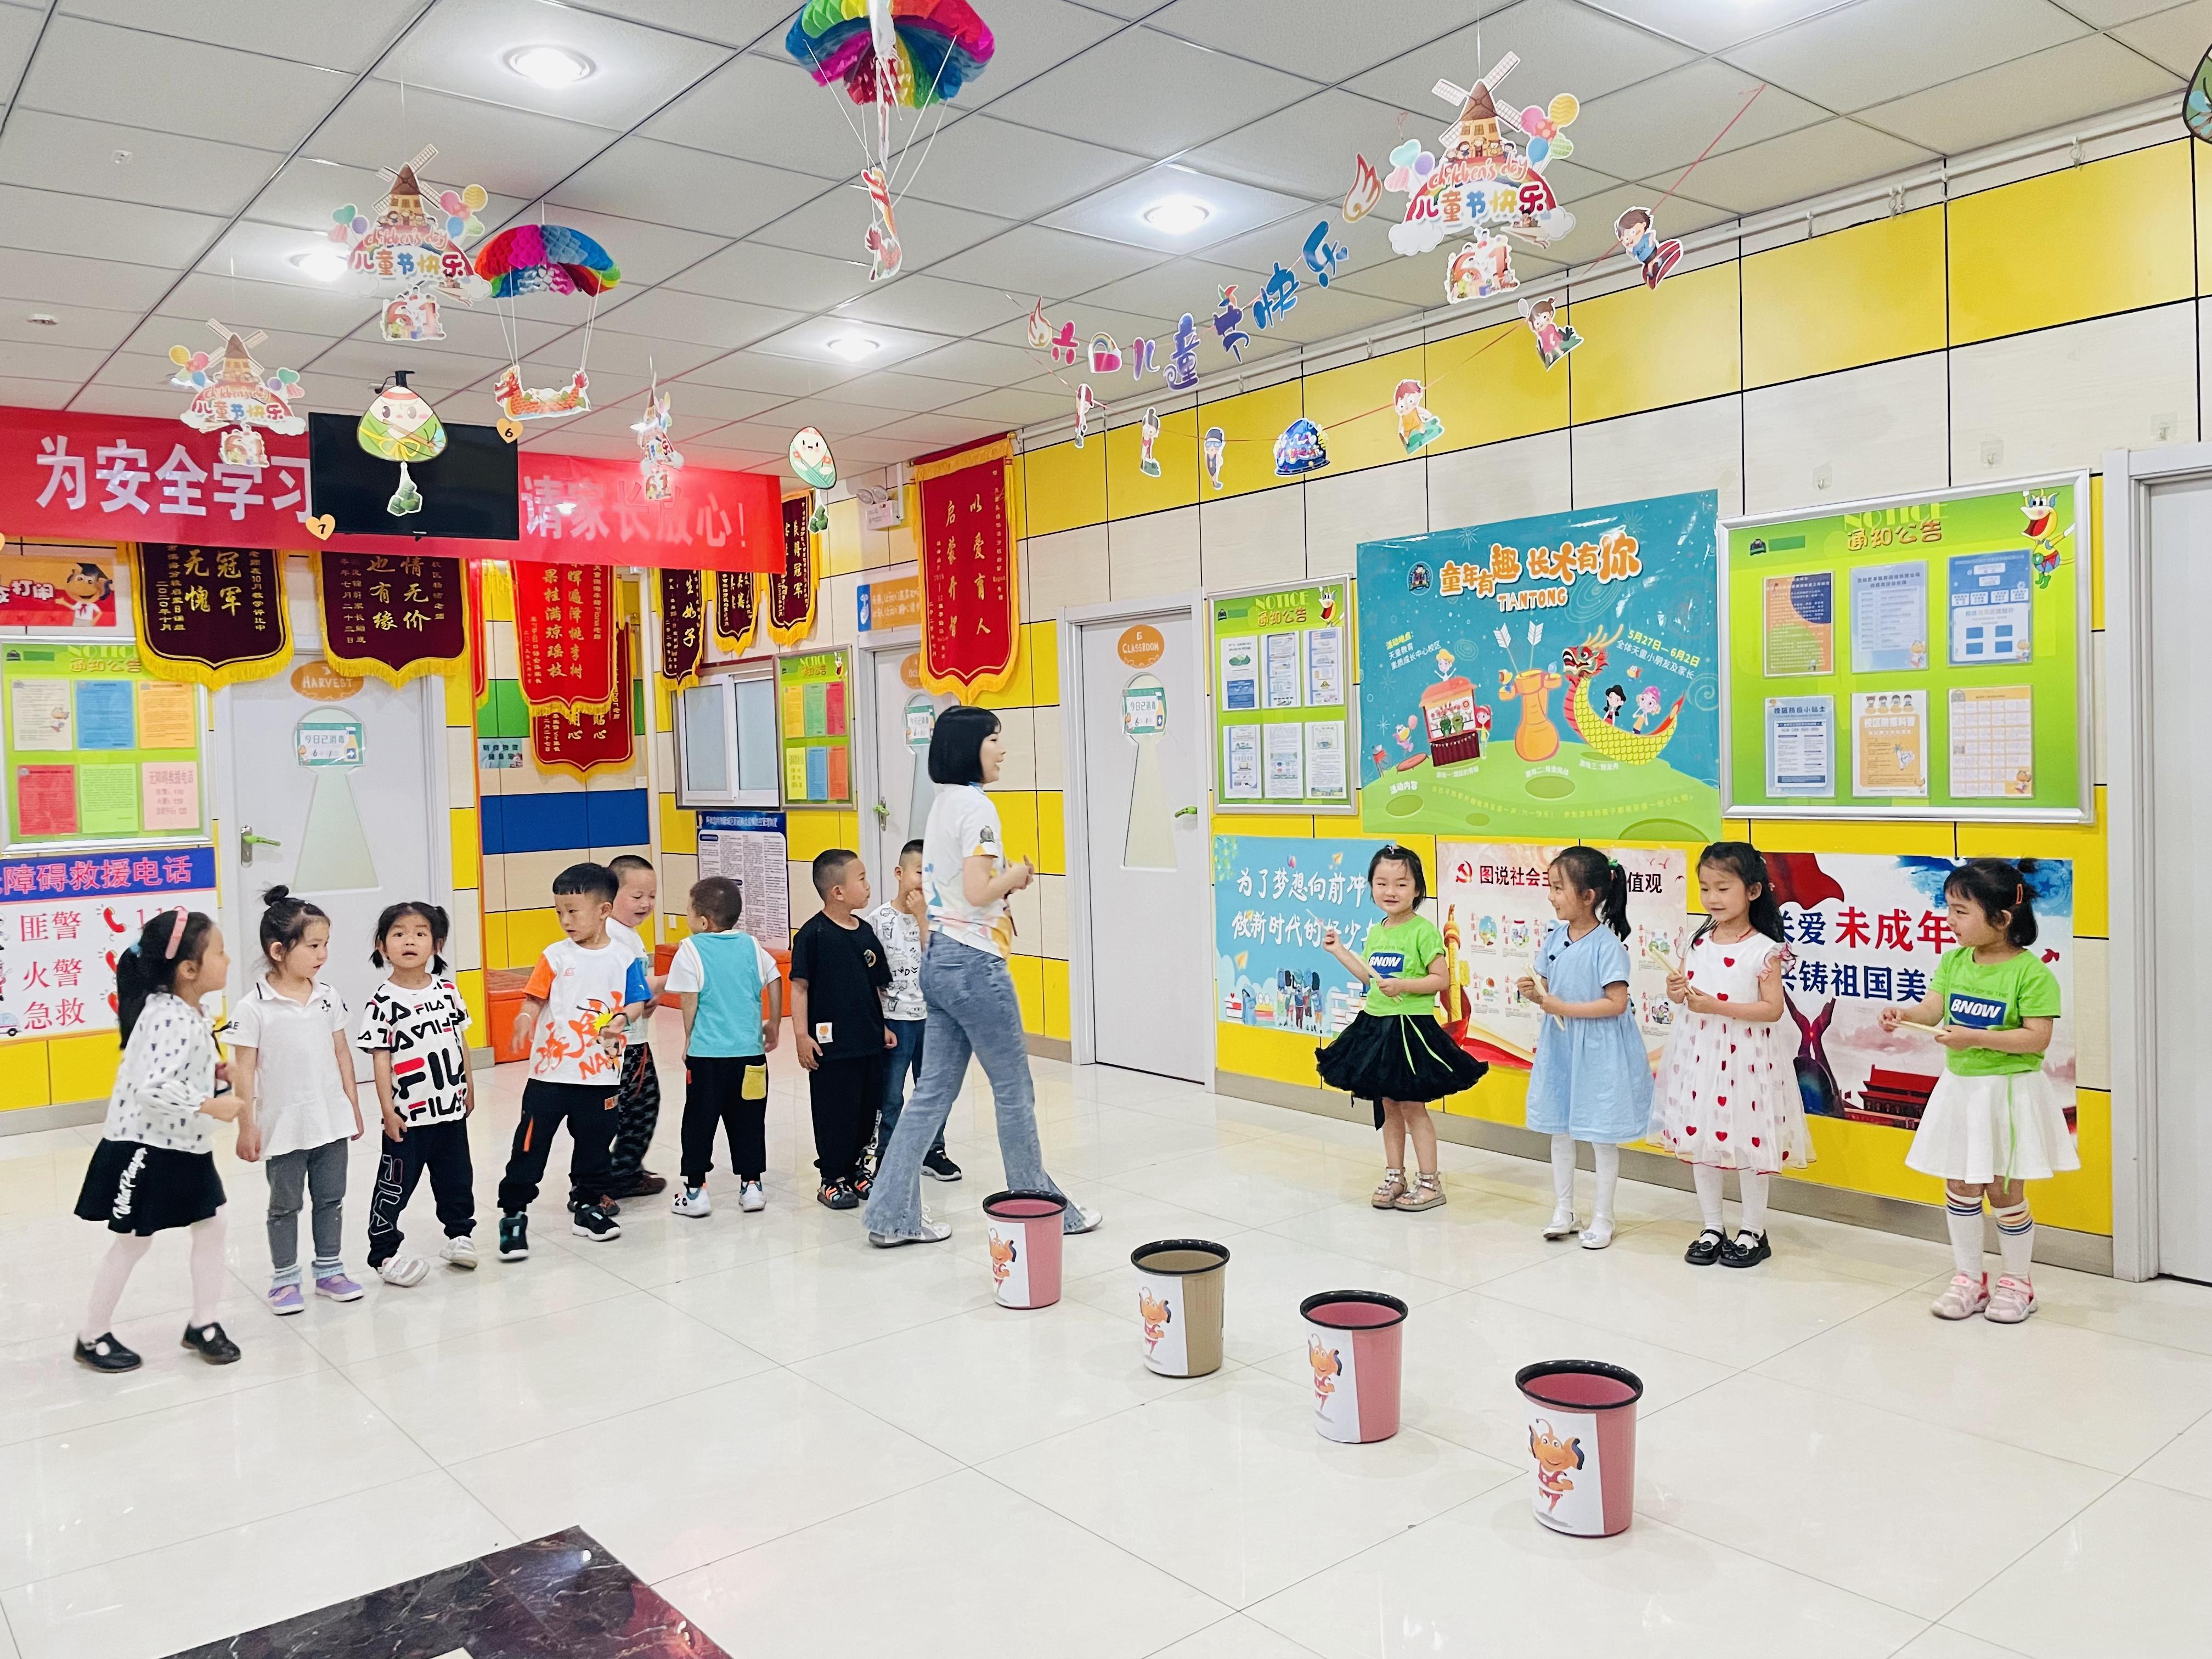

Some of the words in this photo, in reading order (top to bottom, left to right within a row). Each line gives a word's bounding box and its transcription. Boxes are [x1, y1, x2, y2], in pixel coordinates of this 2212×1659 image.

[1428, 161, 1496, 190] children's
[1504, 152, 1530, 180] day
[1415, 184, 1546, 223] 儿童节快乐
[364, 227, 421, 248] children's
[423, 227, 450, 251] day
[354, 251, 465, 277] 儿童节快乐
[195, 400, 285, 421] 儿童节快乐
[505, 428, 513, 438] 6
[36, 435, 311, 523] 为安全学习
[318, 524, 326, 534] 7
[1843, 502, 1950, 532] NOTICE
[1847, 518, 1943, 551] 通知公告
[1441, 544, 1521, 596] 童年有趣
[1528, 533, 1640, 583] 长大有你
[216, 551, 242, 617] 冠军
[366, 556, 398, 631] 也有缘
[400, 556, 432, 633] 情无价
[1255, 590, 1310, 611] NOTICE
[1498, 588, 1567, 611] TIANTONG
[1257, 607, 1307, 627] 通知公告
[1122, 642, 1159, 653] CLASSROOM
[1389, 642, 1414, 661] 天童教育
[1391, 640, 1442, 670] 素质成长中心校区
[1616, 639, 1695, 680] 全体天童小朋友及家长
[70, 658, 141, 673] 通知公告
[302, 675, 353, 689] HARVEST
[1389, 781, 1418, 794] 活动内容
[0, 855, 193, 895] 障碍救援电话
[1237, 867, 1368, 908] 为了梦想向前冲
[21, 910, 82, 942] 匪警
[1835, 905, 1957, 955] 未成年
[22, 958, 83, 991] 火警
[1368, 956, 1402, 967] BNOW
[1782, 960, 1934, 1003] 共铸祖国美
[24, 996, 86, 1030] 急救
[414, 1000, 445, 1015] FILA
[1950, 998, 2002, 1019] BNOW
[370, 1154, 403, 1235] FILA
